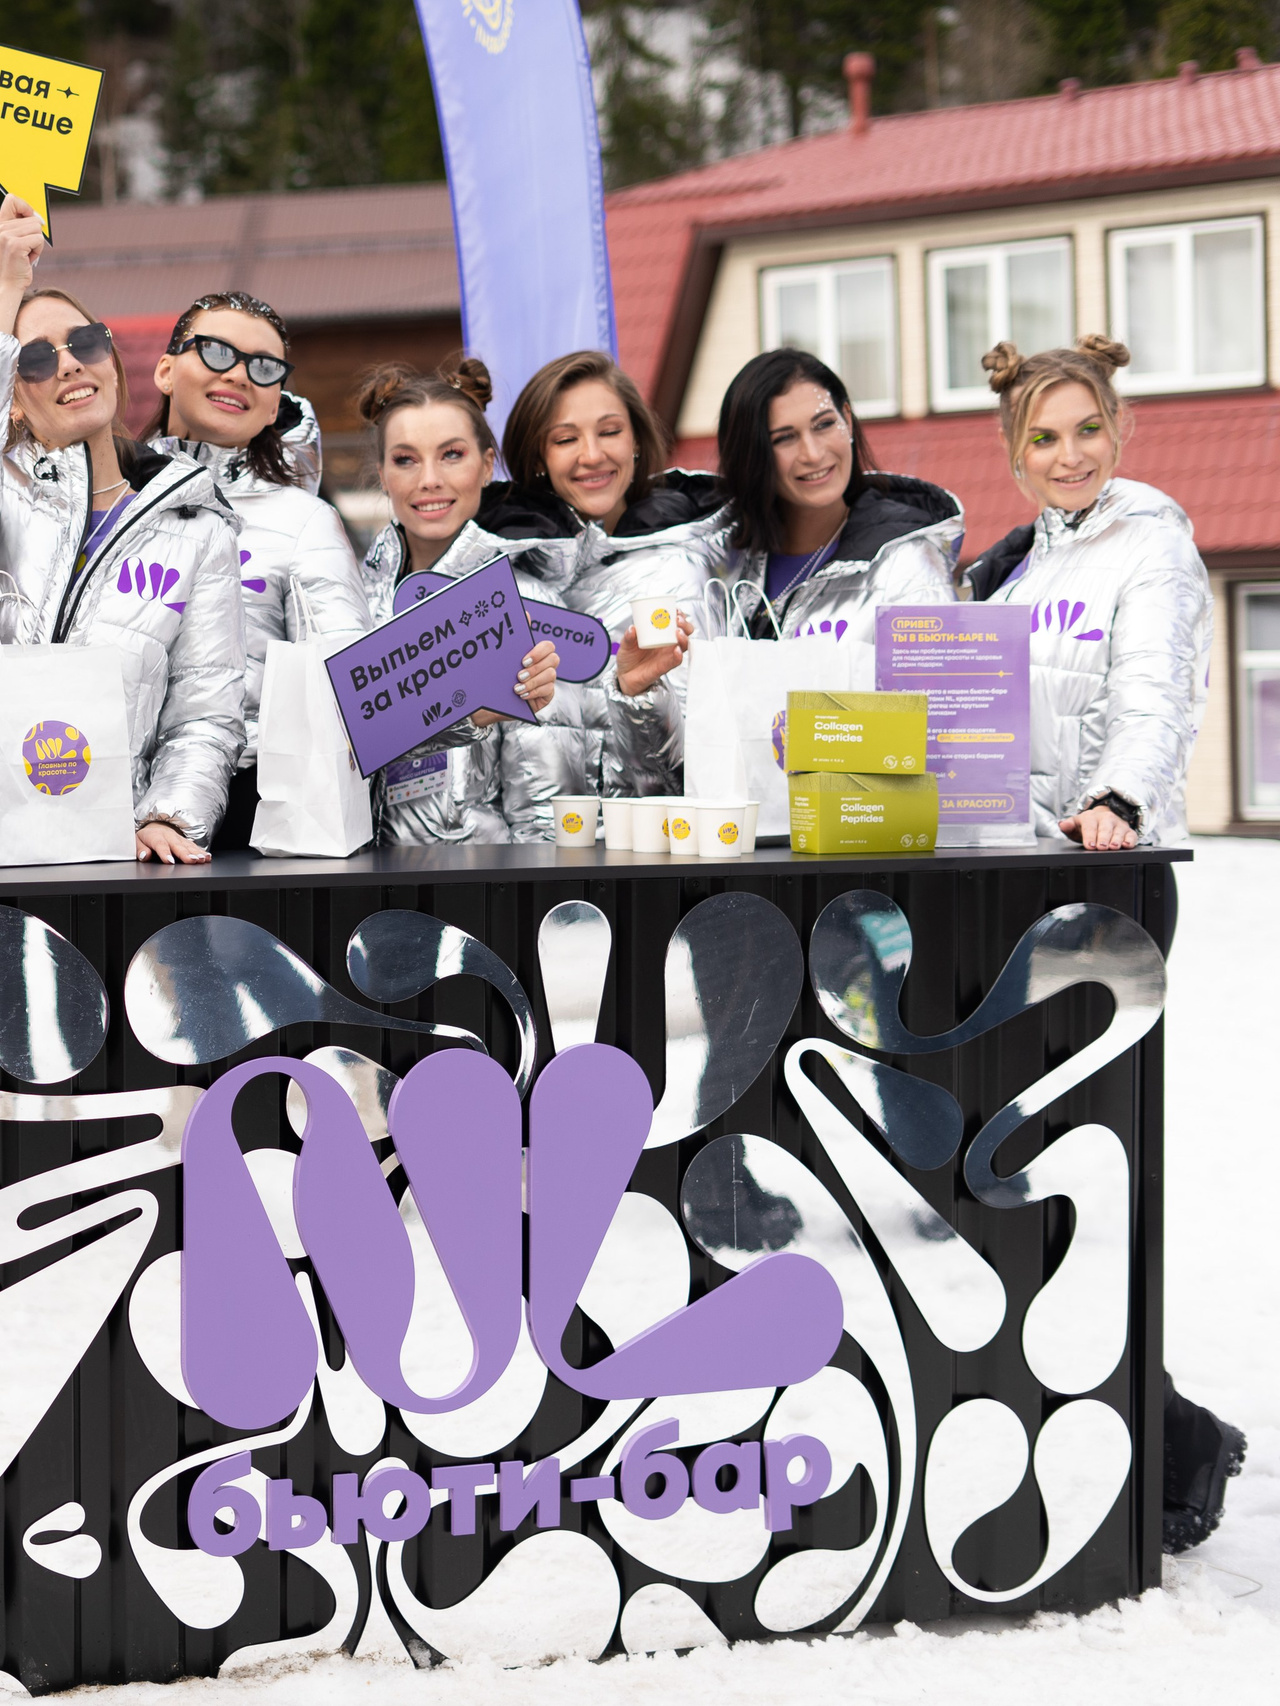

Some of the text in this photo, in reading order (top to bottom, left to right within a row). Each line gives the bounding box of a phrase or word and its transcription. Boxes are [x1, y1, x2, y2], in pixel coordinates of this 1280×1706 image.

[415, 586, 596, 647] З асотой
[896, 620, 938, 629] ПРИВЕТ,
[892, 633, 999, 642] ТЫ В БЬЮТИ-БАРЕ NL
[349, 618, 456, 692] Выпьем
[360, 612, 514, 720] за красоту!
[814, 721, 864, 732] Collagen
[813, 733, 863, 743] Peptides
[38, 769, 67, 777] красоте
[840, 803, 884, 813] Collagen
[942, 799, 1007, 808] ЗА КРАСОТУ!
[840, 814, 884, 824] Peptides
[188, 1417, 833, 1557] бьюти-бар
